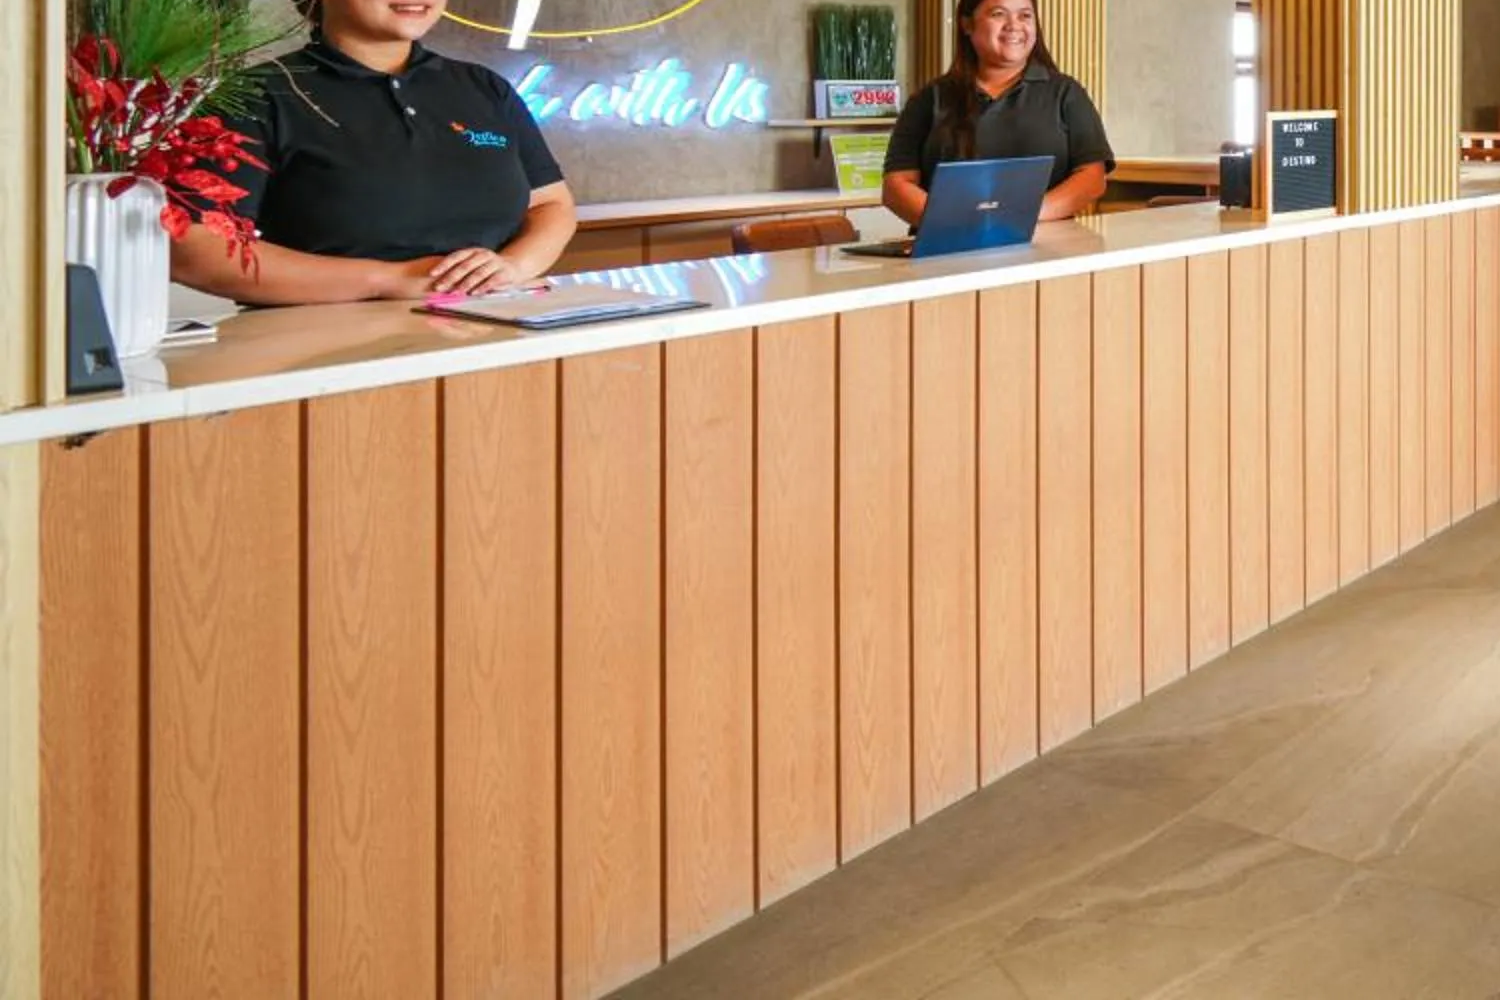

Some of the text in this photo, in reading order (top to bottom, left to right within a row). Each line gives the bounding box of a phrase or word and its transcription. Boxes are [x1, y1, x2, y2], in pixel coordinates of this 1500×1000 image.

[1282, 122, 1318, 133] WELCOME
[1295, 137, 1305, 148] TO
[1281, 155, 1317, 167] DESTINO
